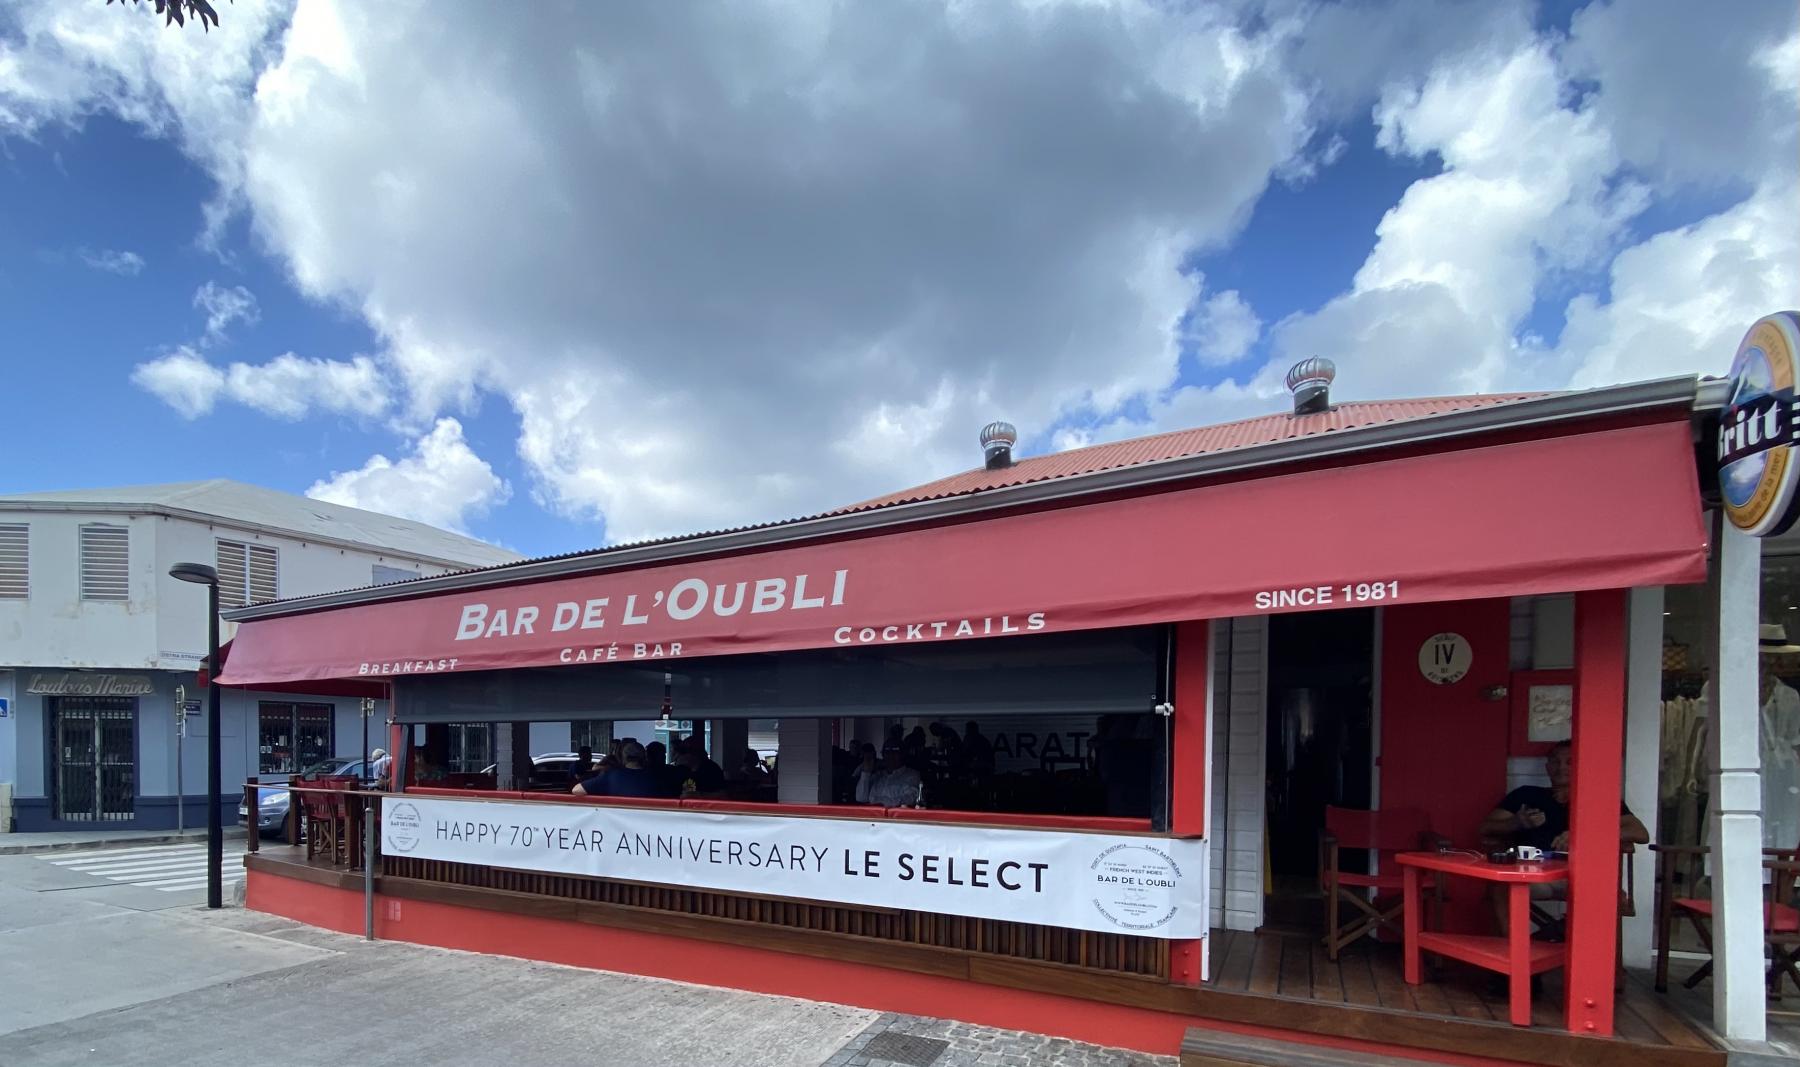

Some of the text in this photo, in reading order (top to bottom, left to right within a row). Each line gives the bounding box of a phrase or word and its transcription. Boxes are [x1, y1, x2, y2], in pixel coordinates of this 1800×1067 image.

[455, 569, 848, 641] BAR DE L'OUBLI
[1255, 581, 1398, 609] SINCE 1981
[834, 612, 1046, 644] COCKTAILS
[559, 641, 683, 663] CAFÉ BAR
[1434, 643, 1456, 665] IV
[358, 658, 458, 675] BREAKFAST
[95, 673, 153, 695] Marine
[992, 732, 1090, 760] ARAT
[436, 820, 502, 844] HAPPY
[543, 827, 604, 853] YEAR
[616, 832, 829, 873] ANNIVERSARY
[844, 849, 881, 878] LE
[898, 853, 1049, 893] SELECT
[1097, 874, 1118, 883] BAR
[1121, 876, 1135, 885] DE
